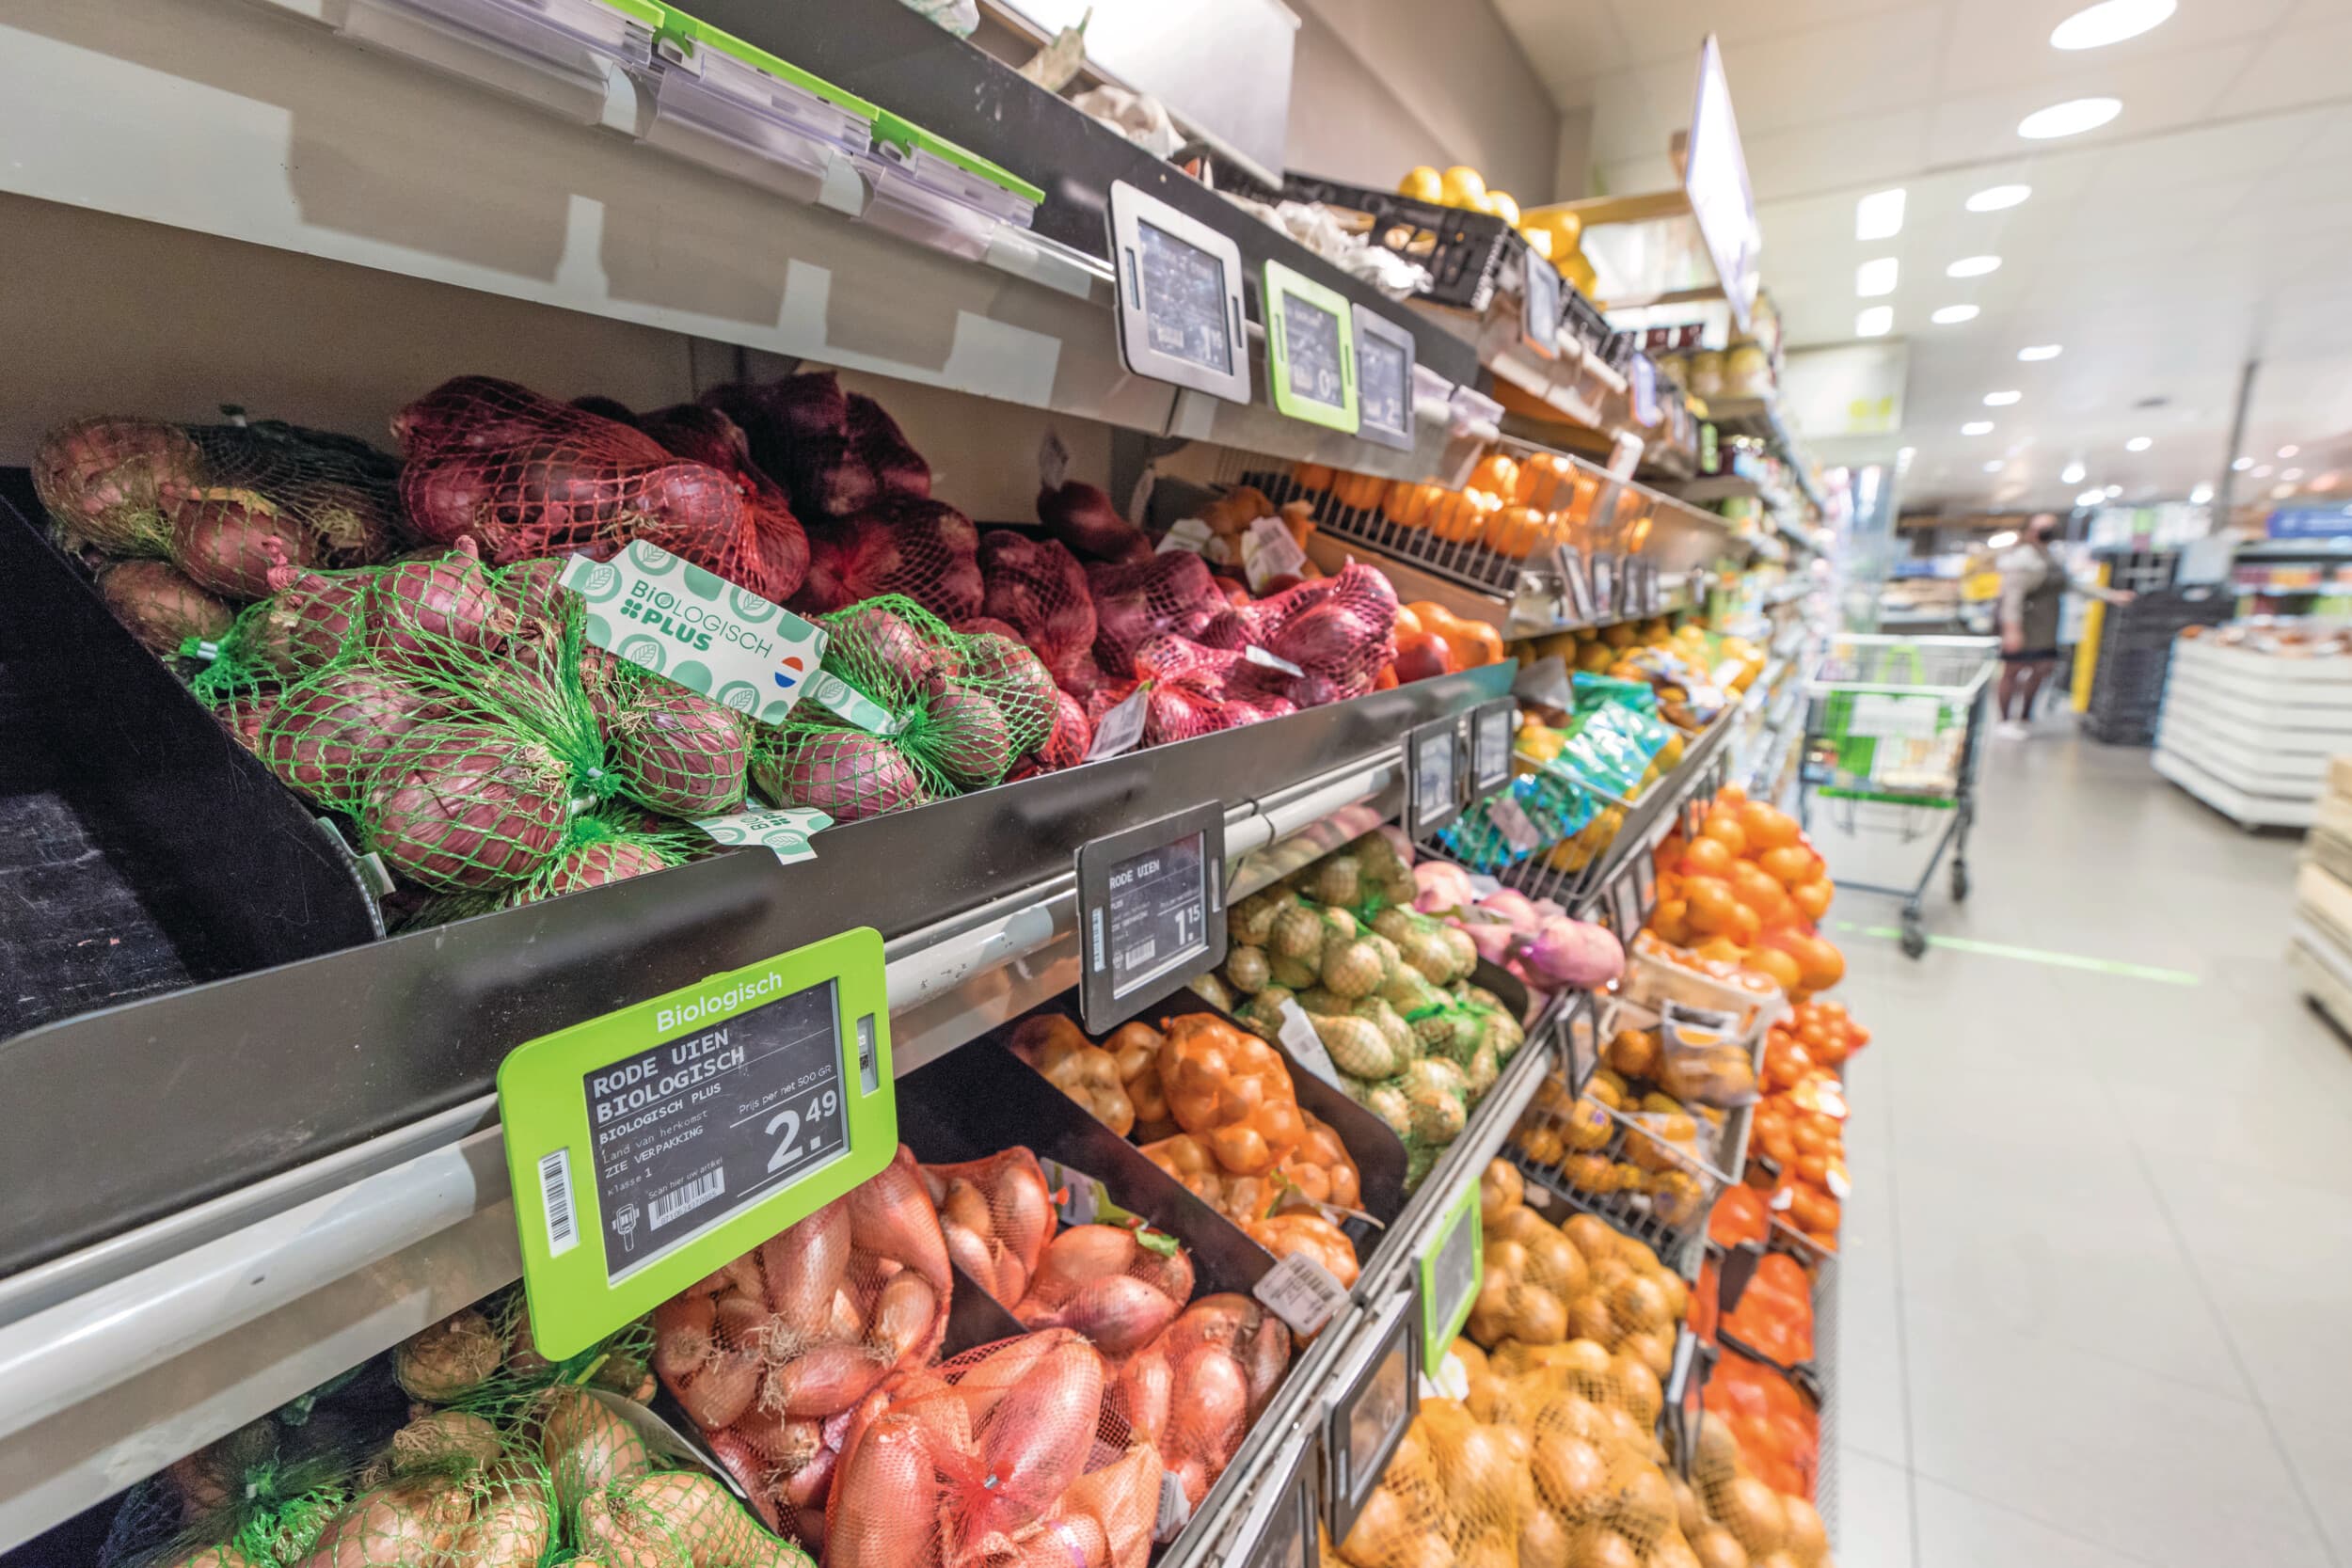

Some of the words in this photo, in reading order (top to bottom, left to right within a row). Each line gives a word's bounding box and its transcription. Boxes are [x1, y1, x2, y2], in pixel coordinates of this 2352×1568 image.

[641, 608, 713, 651] PLUS
[1109, 869, 1134, 890] RODE
[1136, 859, 1160, 879] UIEN
[656, 971, 783, 1033] Biologisch
[593, 1056, 659, 1099] RODE
[671, 1028, 729, 1065] UIEN
[596, 1045, 745, 1124] BIOLOGISCH
[739, 1099, 759, 1115] Prijs
[762, 1091, 778, 1104] per
[780, 1082, 796, 1096] net
[798, 1071, 817, 1087] 500
[818, 1064, 833, 1077] GR
[599, 1099, 683, 1145] BIOLOGISCH
[691, 1083, 722, 1103] PLUS
[603, 1144, 630, 1164] Land
[635, 1135, 655, 1148] van
[660, 1110, 708, 1137] herkomst
[605, 1160, 628, 1179] ZIE
[634, 1125, 704, 1164] VERPAKKING
[644, 1167, 652, 1178] 1
[648, 1186, 667, 1199] Scan
[670, 1177, 684, 1189] hier
[687, 1170, 698, 1180] uw
[700, 1156, 723, 1174] artikel
